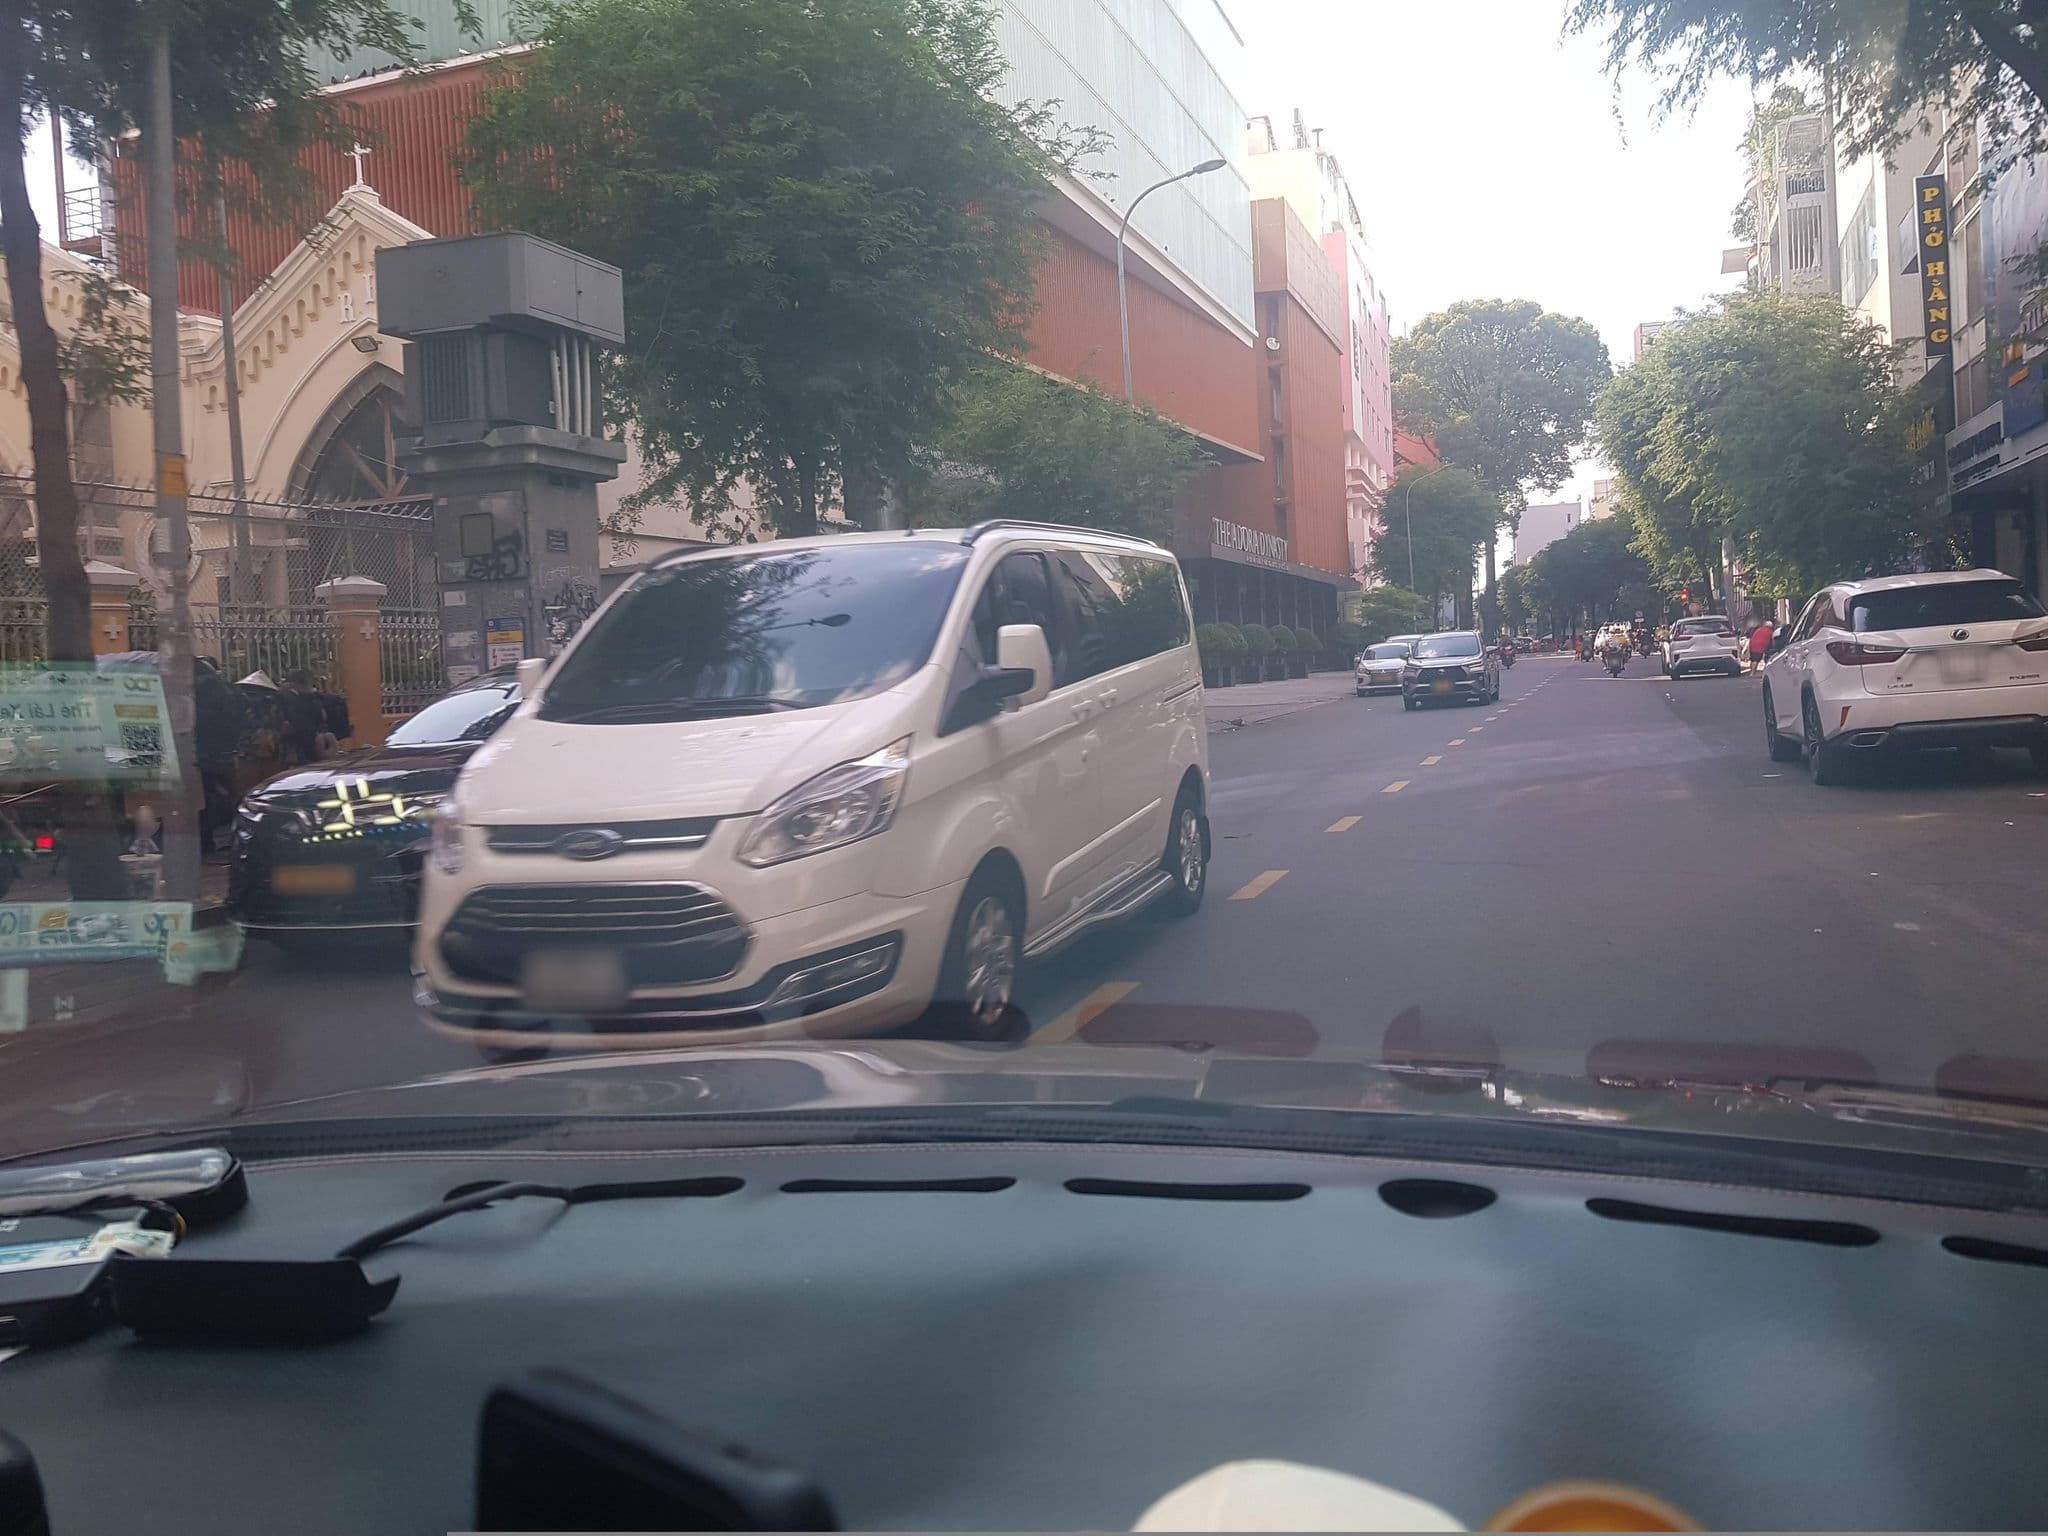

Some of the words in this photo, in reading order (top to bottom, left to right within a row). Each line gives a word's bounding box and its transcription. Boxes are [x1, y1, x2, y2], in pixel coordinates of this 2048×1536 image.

[1922, 187, 1944, 247] PHỞ
[1212, 516, 1231, 547] THE
[1231, 522, 1260, 555] ADORA
